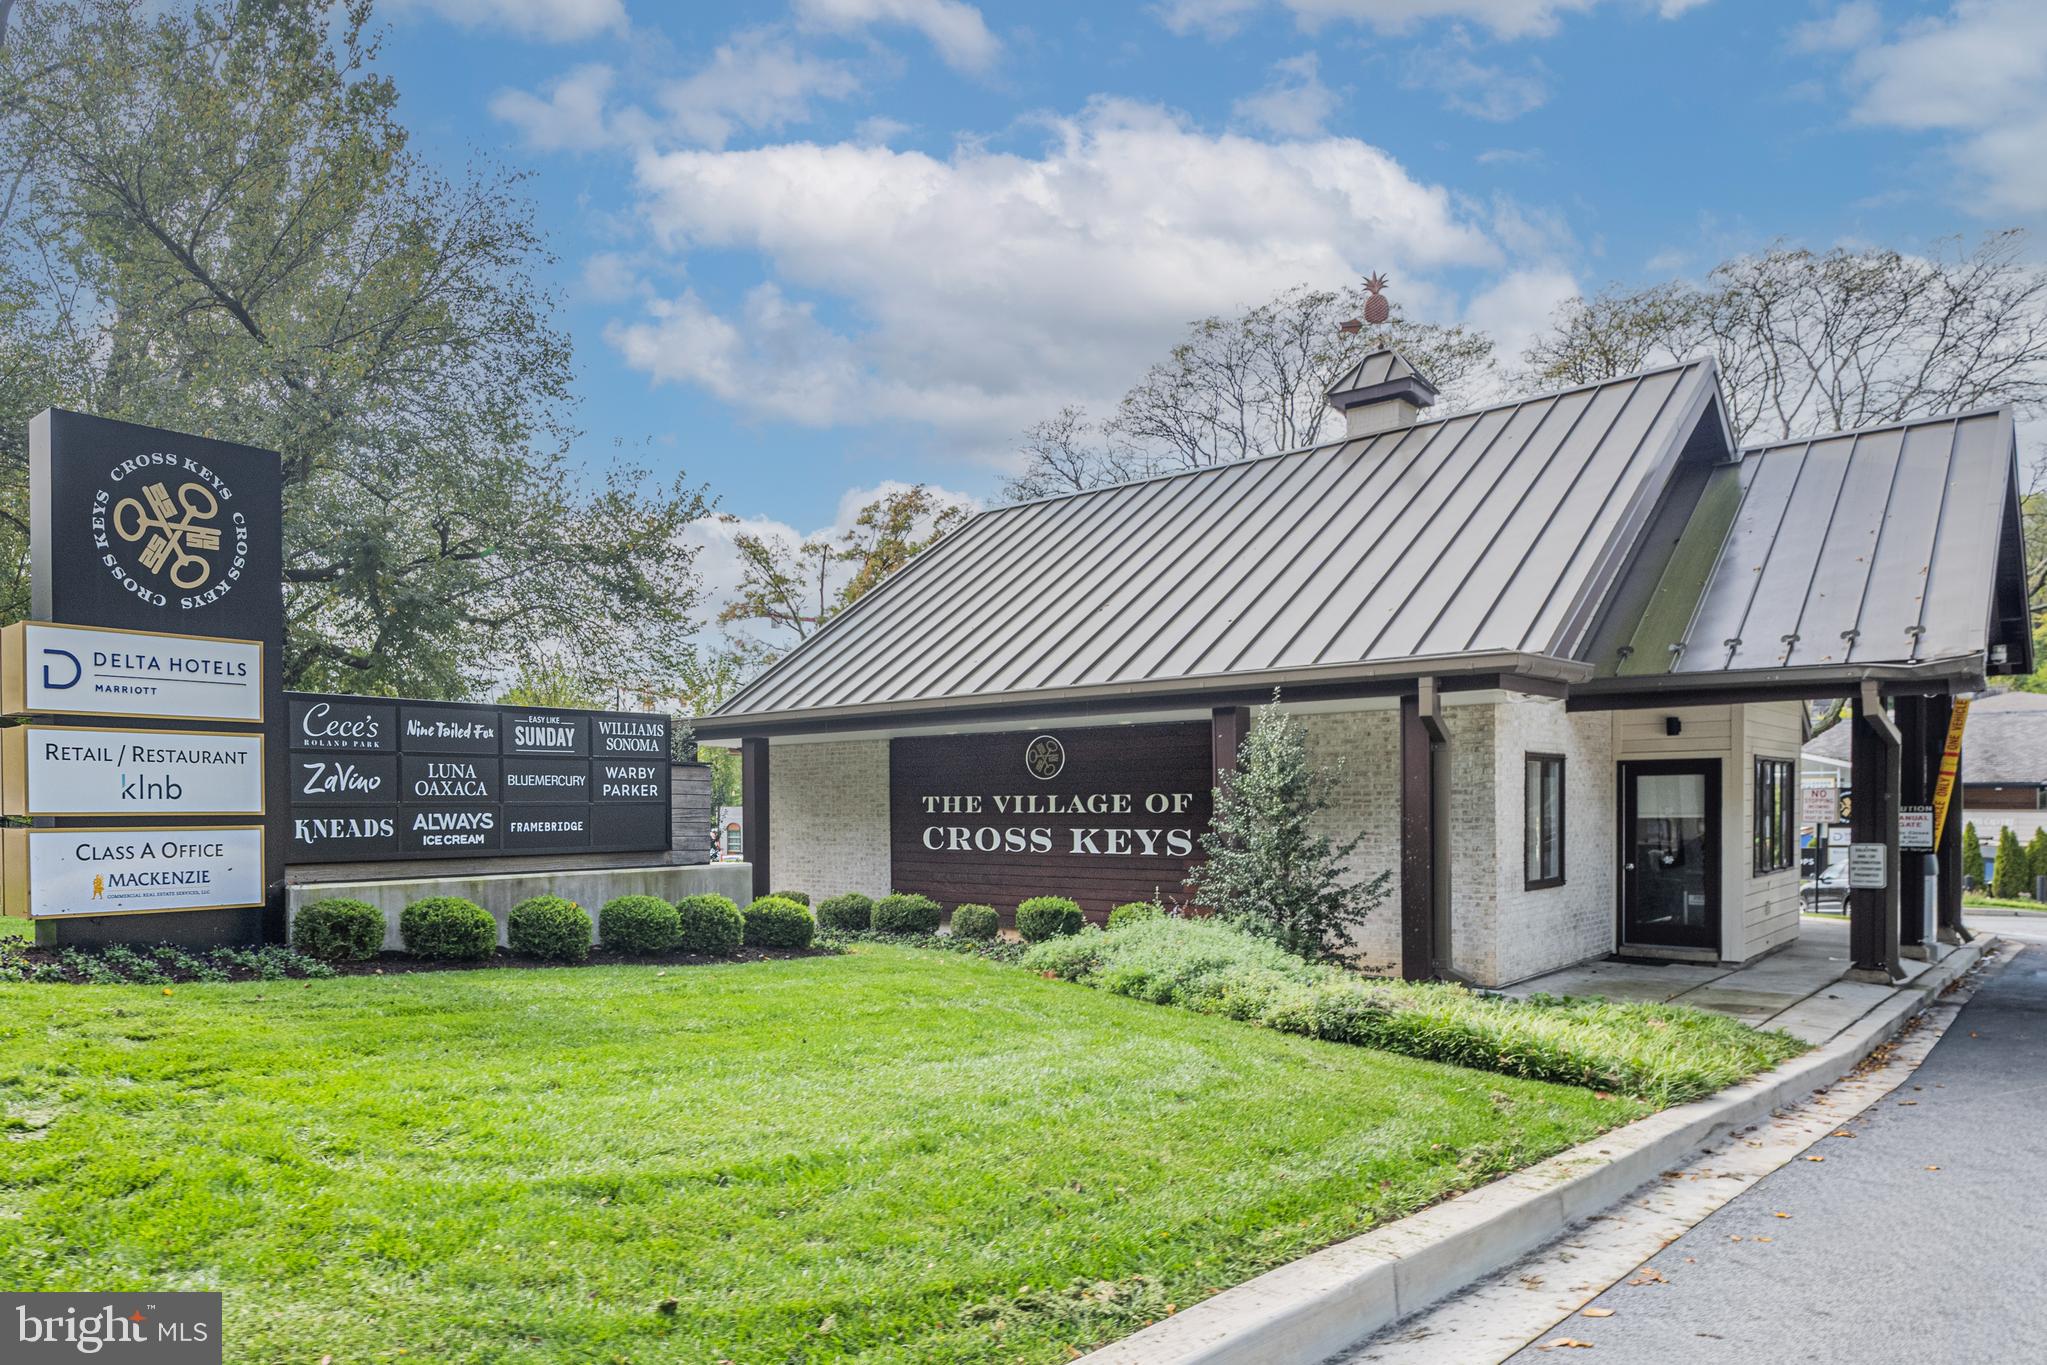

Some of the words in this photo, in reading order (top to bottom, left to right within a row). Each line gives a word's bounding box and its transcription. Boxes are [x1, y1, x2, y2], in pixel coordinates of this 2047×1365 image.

[110, 452, 178, 482] CROSS
[183, 457, 233, 501] KEYS
[92, 490, 110, 549] KEYS
[228, 512, 248, 581] CROSS
[103, 553, 167, 607] CROSS
[180, 582, 232, 609] KEYS
[93, 652, 161, 672] DELTA
[169, 657, 247, 677] HOTELS
[95, 684, 158, 695] MARRIOTT
[303, 702, 379, 738] Cece's
[528, 715, 545, 724] EASY
[546, 716, 560, 725] LIKE
[1952, 699, 1968, 731] VEHICLE
[406, 719, 435, 737] Nine
[436, 722, 472, 739] Tailed
[473, 724, 495, 739] Fox
[515, 726, 575, 747] SUNDAY
[598, 721, 664, 737] WILLIAMS
[304, 739, 348, 747] ROLAND
[606, 737, 660, 752] SONOMA
[1947, 734, 1960, 750] ONE
[46, 743, 113, 762] RETAIL
[117, 744, 126, 767] /
[132, 746, 248, 765] RESTAURANT
[303, 762, 381, 794] ZaVino
[428, 763, 477, 779] LUNA
[507, 774, 586, 787] BLUEMERCURY
[605, 766, 656, 779] WARBY
[121, 773, 182, 800] klnb
[415, 780, 488, 796] OAXACA
[603, 784, 658, 797] PARKER
[1811, 790, 1827, 798] NO
[1938, 777, 1951, 797] ONLY
[922, 795, 982, 814] THE
[992, 793, 1132, 814] VILLAGE
[1145, 793, 1193, 814] OF
[294, 818, 394, 844] KNEADS
[412, 812, 494, 831] ALWAYS
[510, 821, 584, 833] FRAMEBRIDGE
[423, 835, 443, 846] ICE
[443, 834, 485, 845] CREAM
[922, 826, 1053, 853] CROSS
[1069, 827, 1193, 857] KEYS
[76, 843, 134, 861] CLASS
[141, 842, 156, 859] A
[161, 841, 224, 858] OFFICE
[108, 870, 211, 887] MACKENZIE
